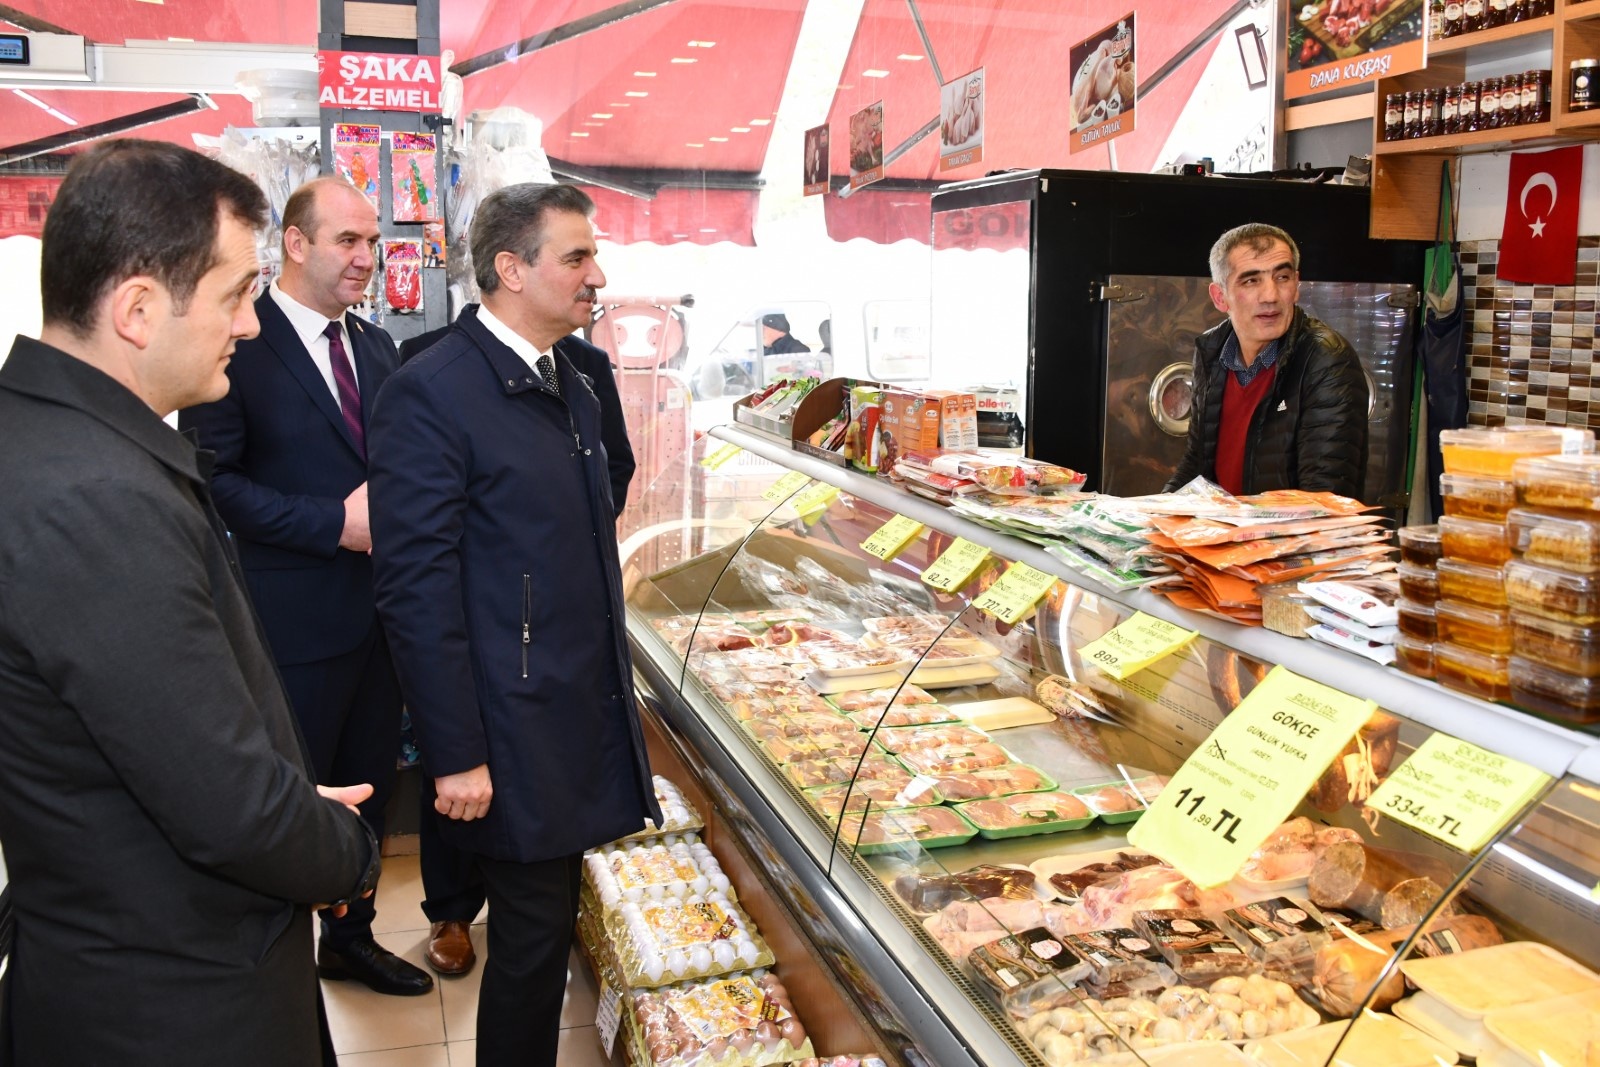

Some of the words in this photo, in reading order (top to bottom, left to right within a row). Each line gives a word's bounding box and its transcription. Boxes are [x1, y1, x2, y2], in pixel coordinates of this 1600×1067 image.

[339, 55, 435, 85] ŞAKA
[1310, 67, 1339, 88] DANA
[1343, 54, 1392, 79] KUŞBAŞI
[1081, 128, 1101, 145] BÜTÜN
[1102, 119, 1121, 137] TAVUK
[1001, 607, 1013, 618] TL
[1272, 710, 1319, 739] GÖKÇE
[1246, 725, 1280, 747] GÜNLÜK
[1280, 742, 1307, 761] YUFKA
[1211, 808, 1243, 844] TL
[1438, 814, 1463, 837] TL
